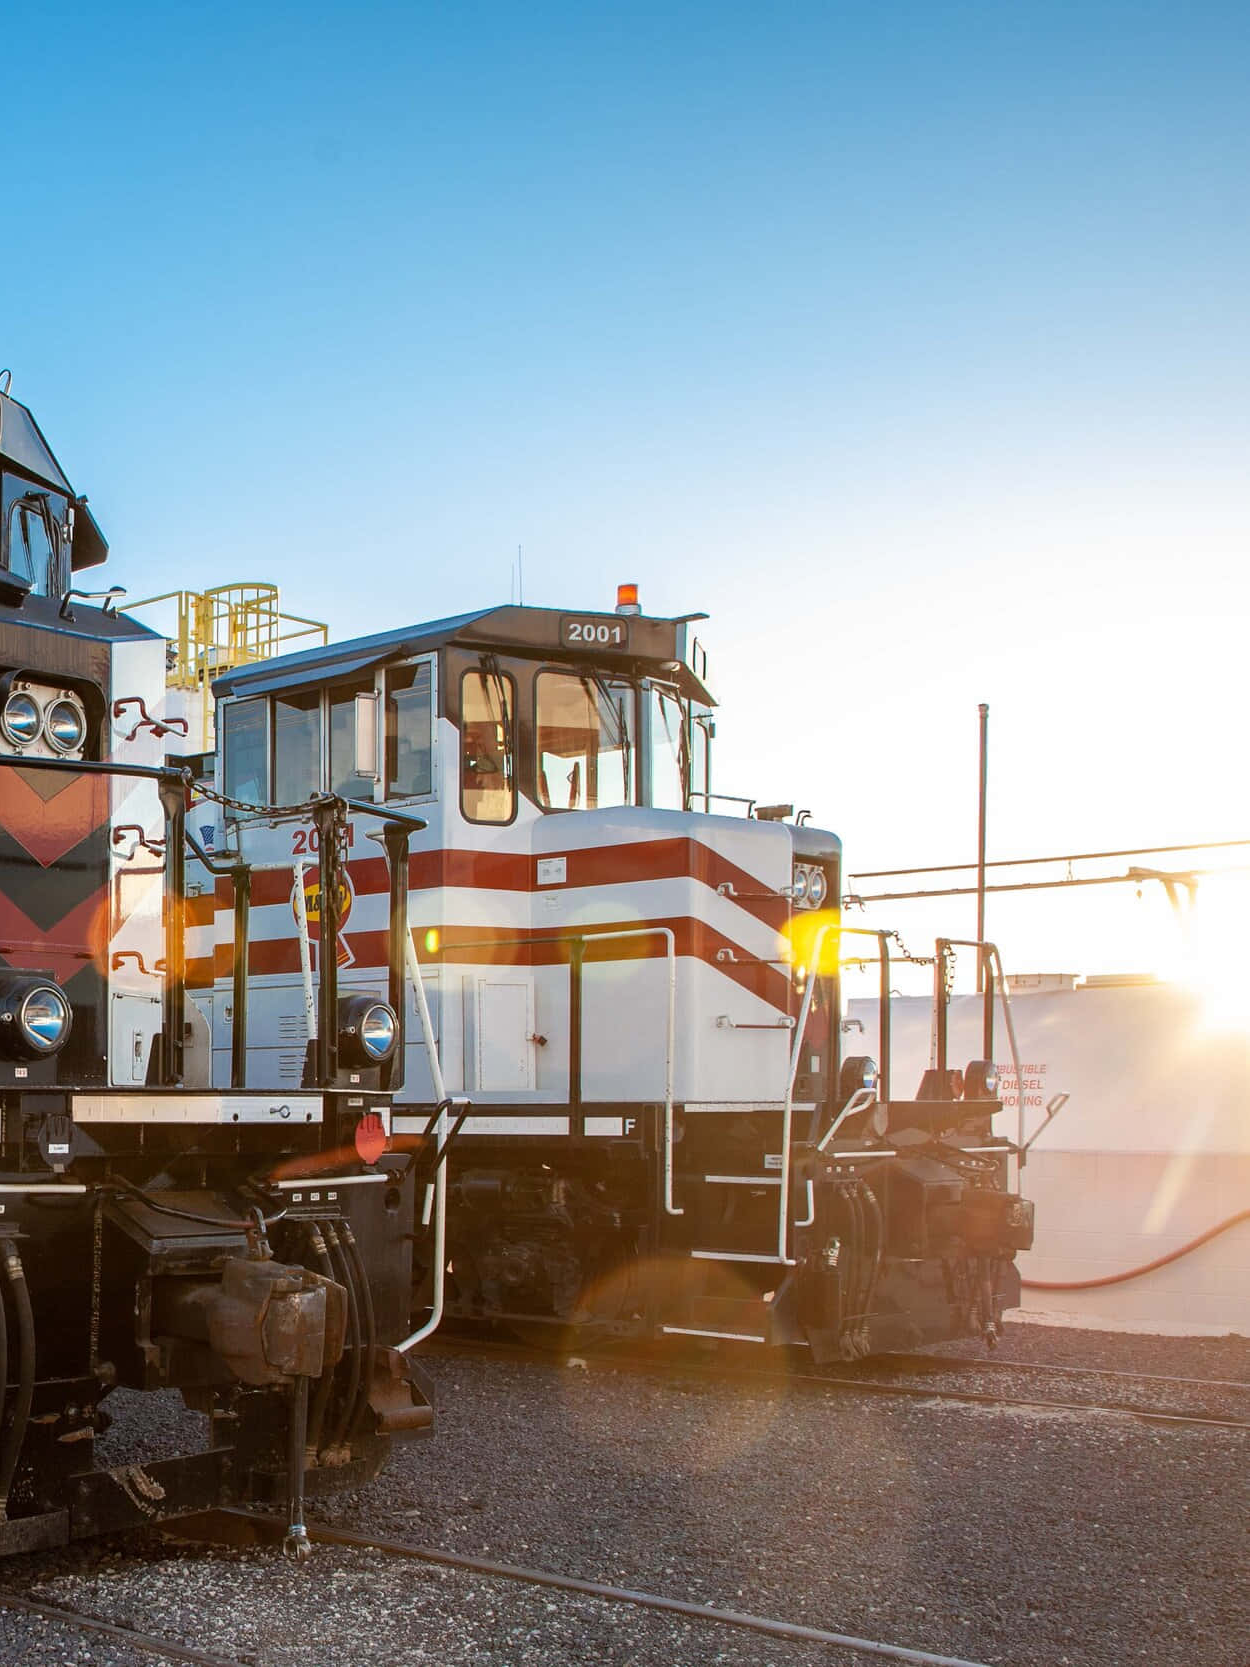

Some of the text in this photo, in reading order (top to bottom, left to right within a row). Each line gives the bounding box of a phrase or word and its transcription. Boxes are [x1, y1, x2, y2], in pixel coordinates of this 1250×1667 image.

[568, 623, 621, 644] 2001
[292, 823, 354, 855] 201
[625, 1119, 636, 1135] F
